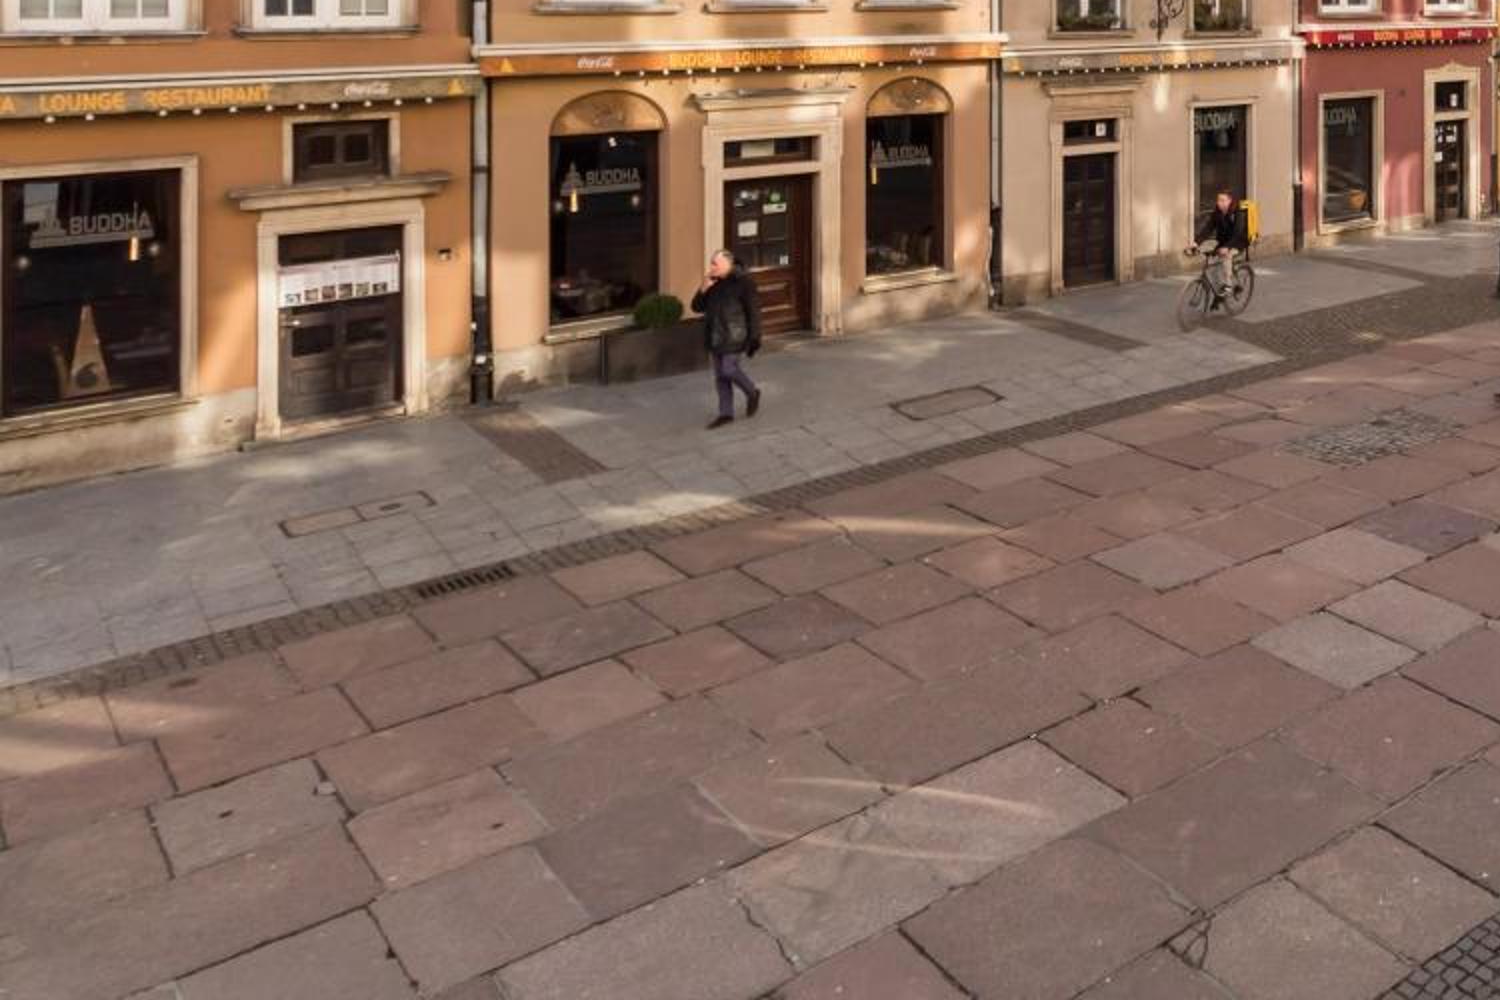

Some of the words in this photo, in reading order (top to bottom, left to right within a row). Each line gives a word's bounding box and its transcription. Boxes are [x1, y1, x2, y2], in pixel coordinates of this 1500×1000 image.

[39, 91, 126, 113] LOUNGE
[144, 83, 272, 110] RESTAURANT
[585, 168, 639, 185] BUDDHA
[69, 210, 151, 235] BUDDHA
